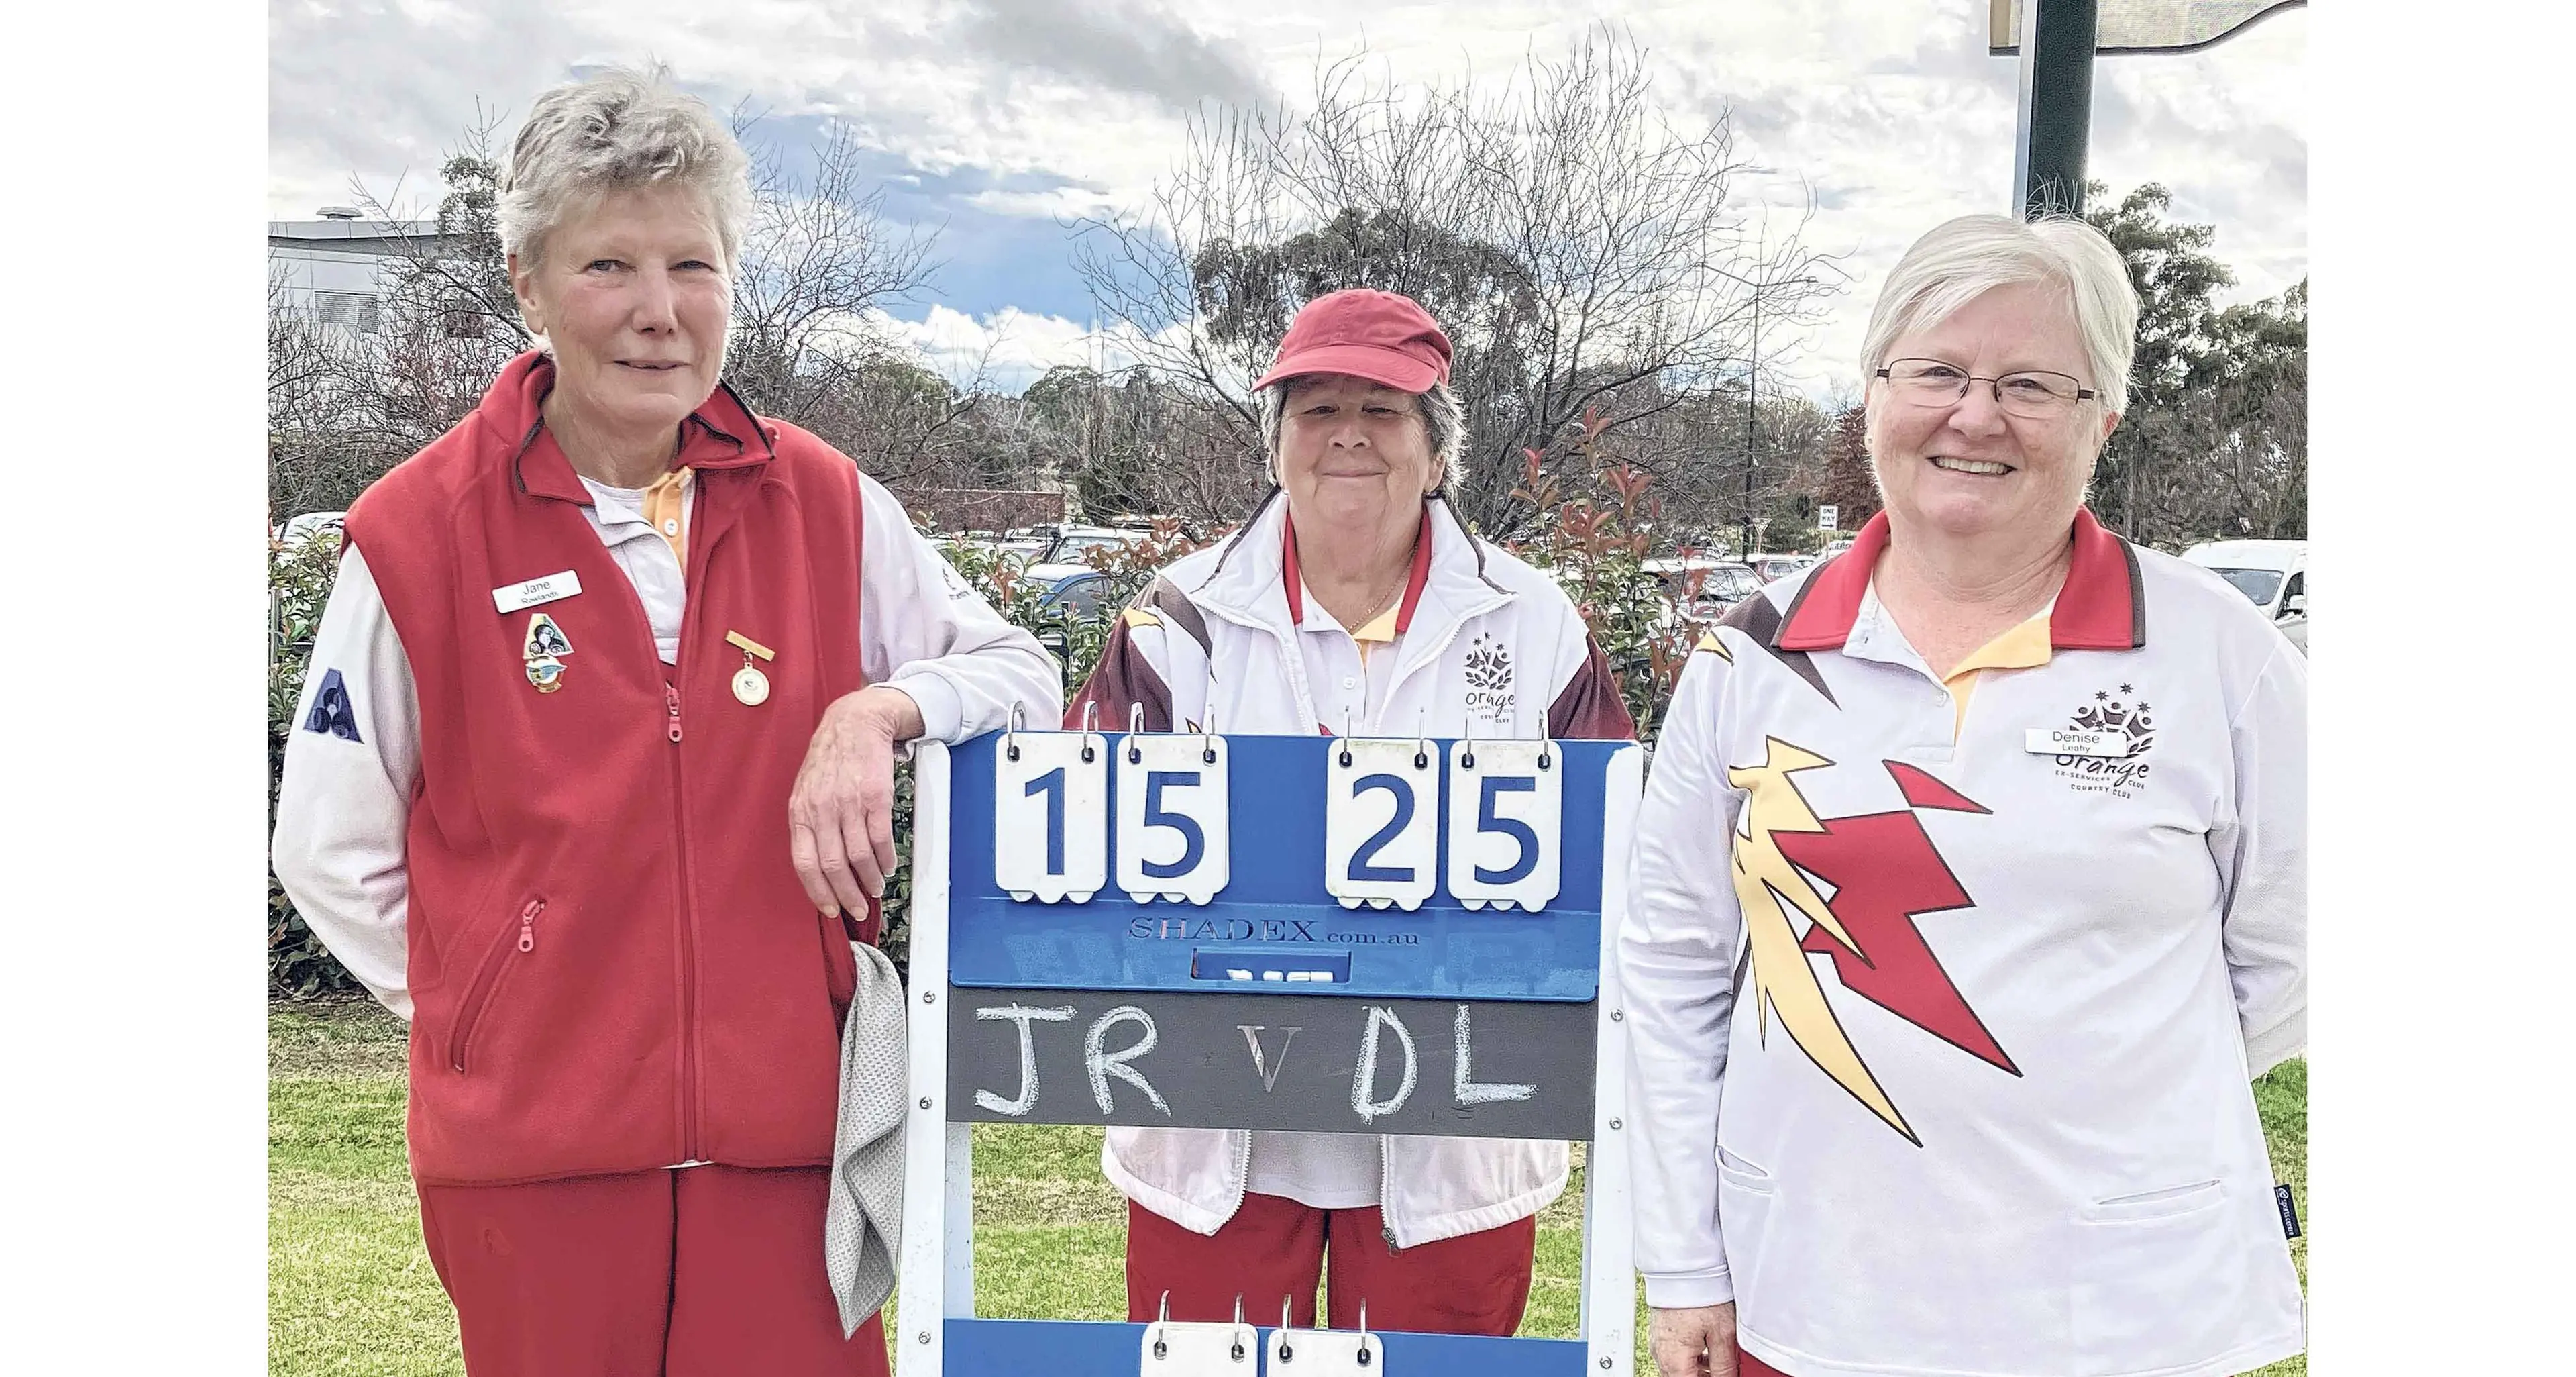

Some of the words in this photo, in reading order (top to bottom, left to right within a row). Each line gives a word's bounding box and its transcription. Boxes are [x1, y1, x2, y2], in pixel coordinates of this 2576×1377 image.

[523, 581, 551, 595] Jane
[2052, 731, 2100, 744] Denise
[2062, 744, 2091, 753] Leahy
[2070, 783, 2110, 793] COUNTRY
